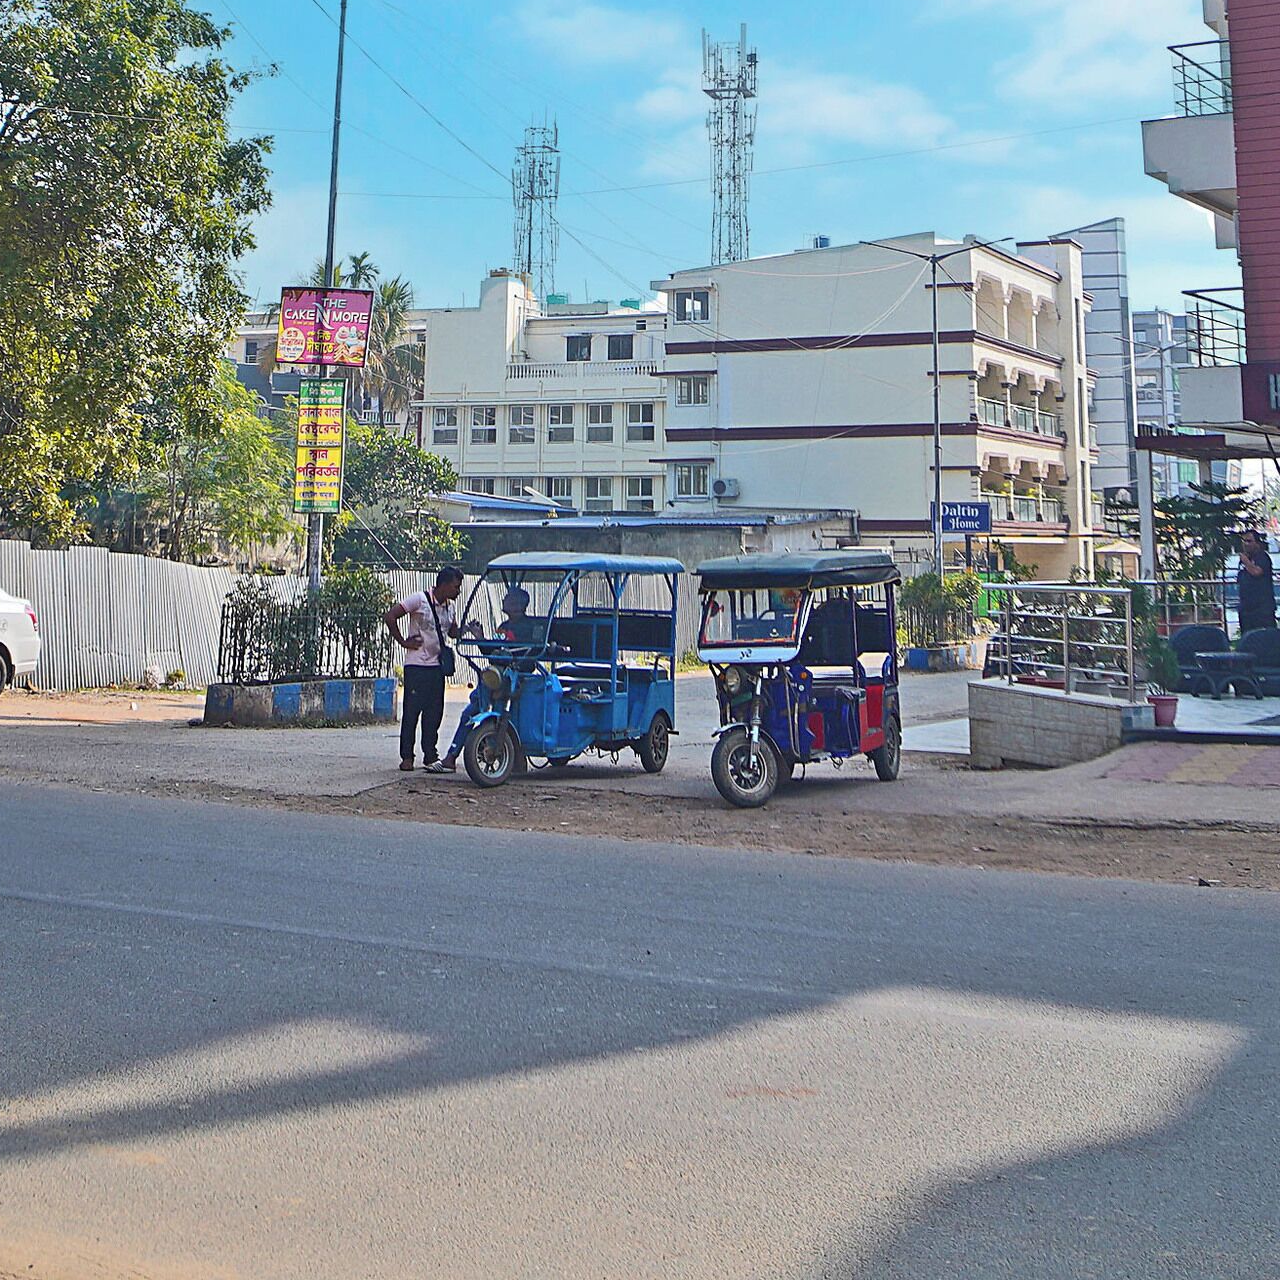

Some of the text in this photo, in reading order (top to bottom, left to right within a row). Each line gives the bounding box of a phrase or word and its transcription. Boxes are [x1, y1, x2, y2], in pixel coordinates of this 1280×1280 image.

[321, 298, 348, 309] THE
[284, 308, 316, 321] CAKE
[331, 310, 370, 324] MORE
[949, 517, 980, 529] Home
